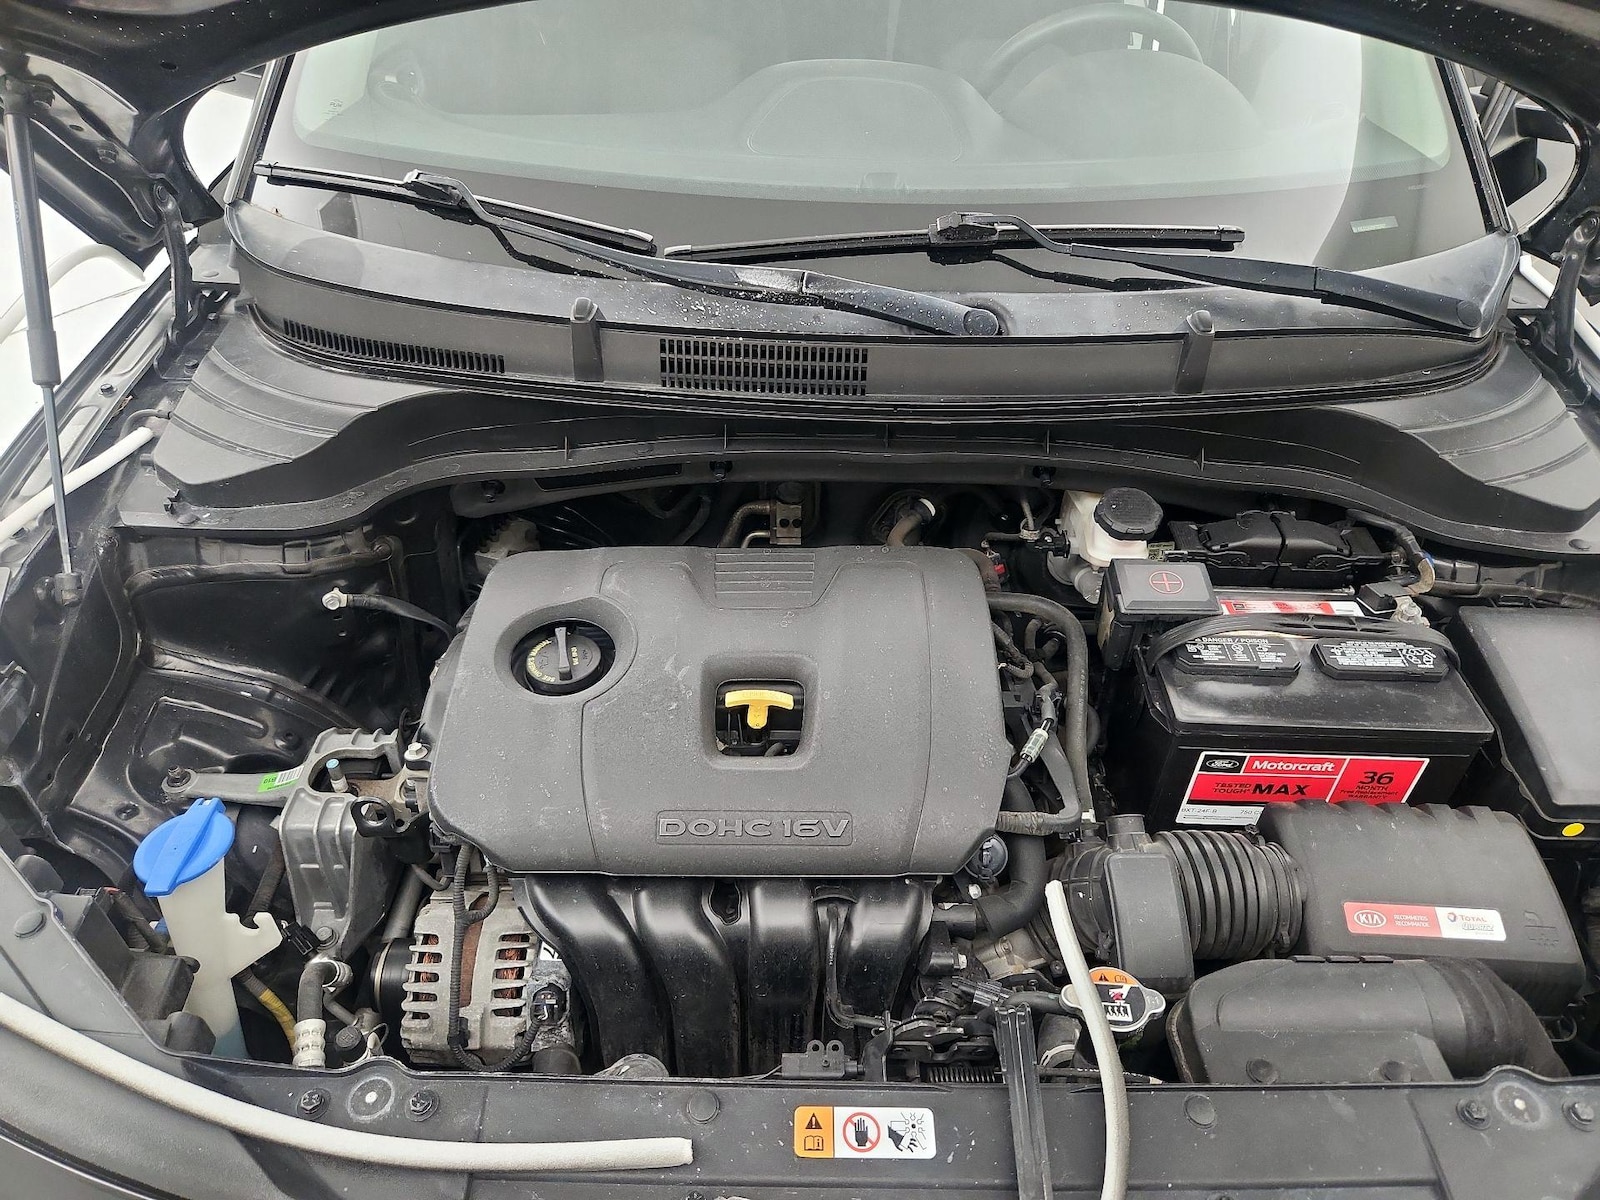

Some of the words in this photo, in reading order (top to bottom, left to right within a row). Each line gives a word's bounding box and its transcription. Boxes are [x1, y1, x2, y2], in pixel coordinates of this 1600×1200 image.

[1251, 760, 1335, 772] Motorcraft
[1358, 771, 1394, 785] 36
[1252, 783, 1310, 795] MAX
[659, 818, 772, 837] DOHC
[782, 818, 850, 838] 16V
[1459, 914, 1488, 923] TOTAL
